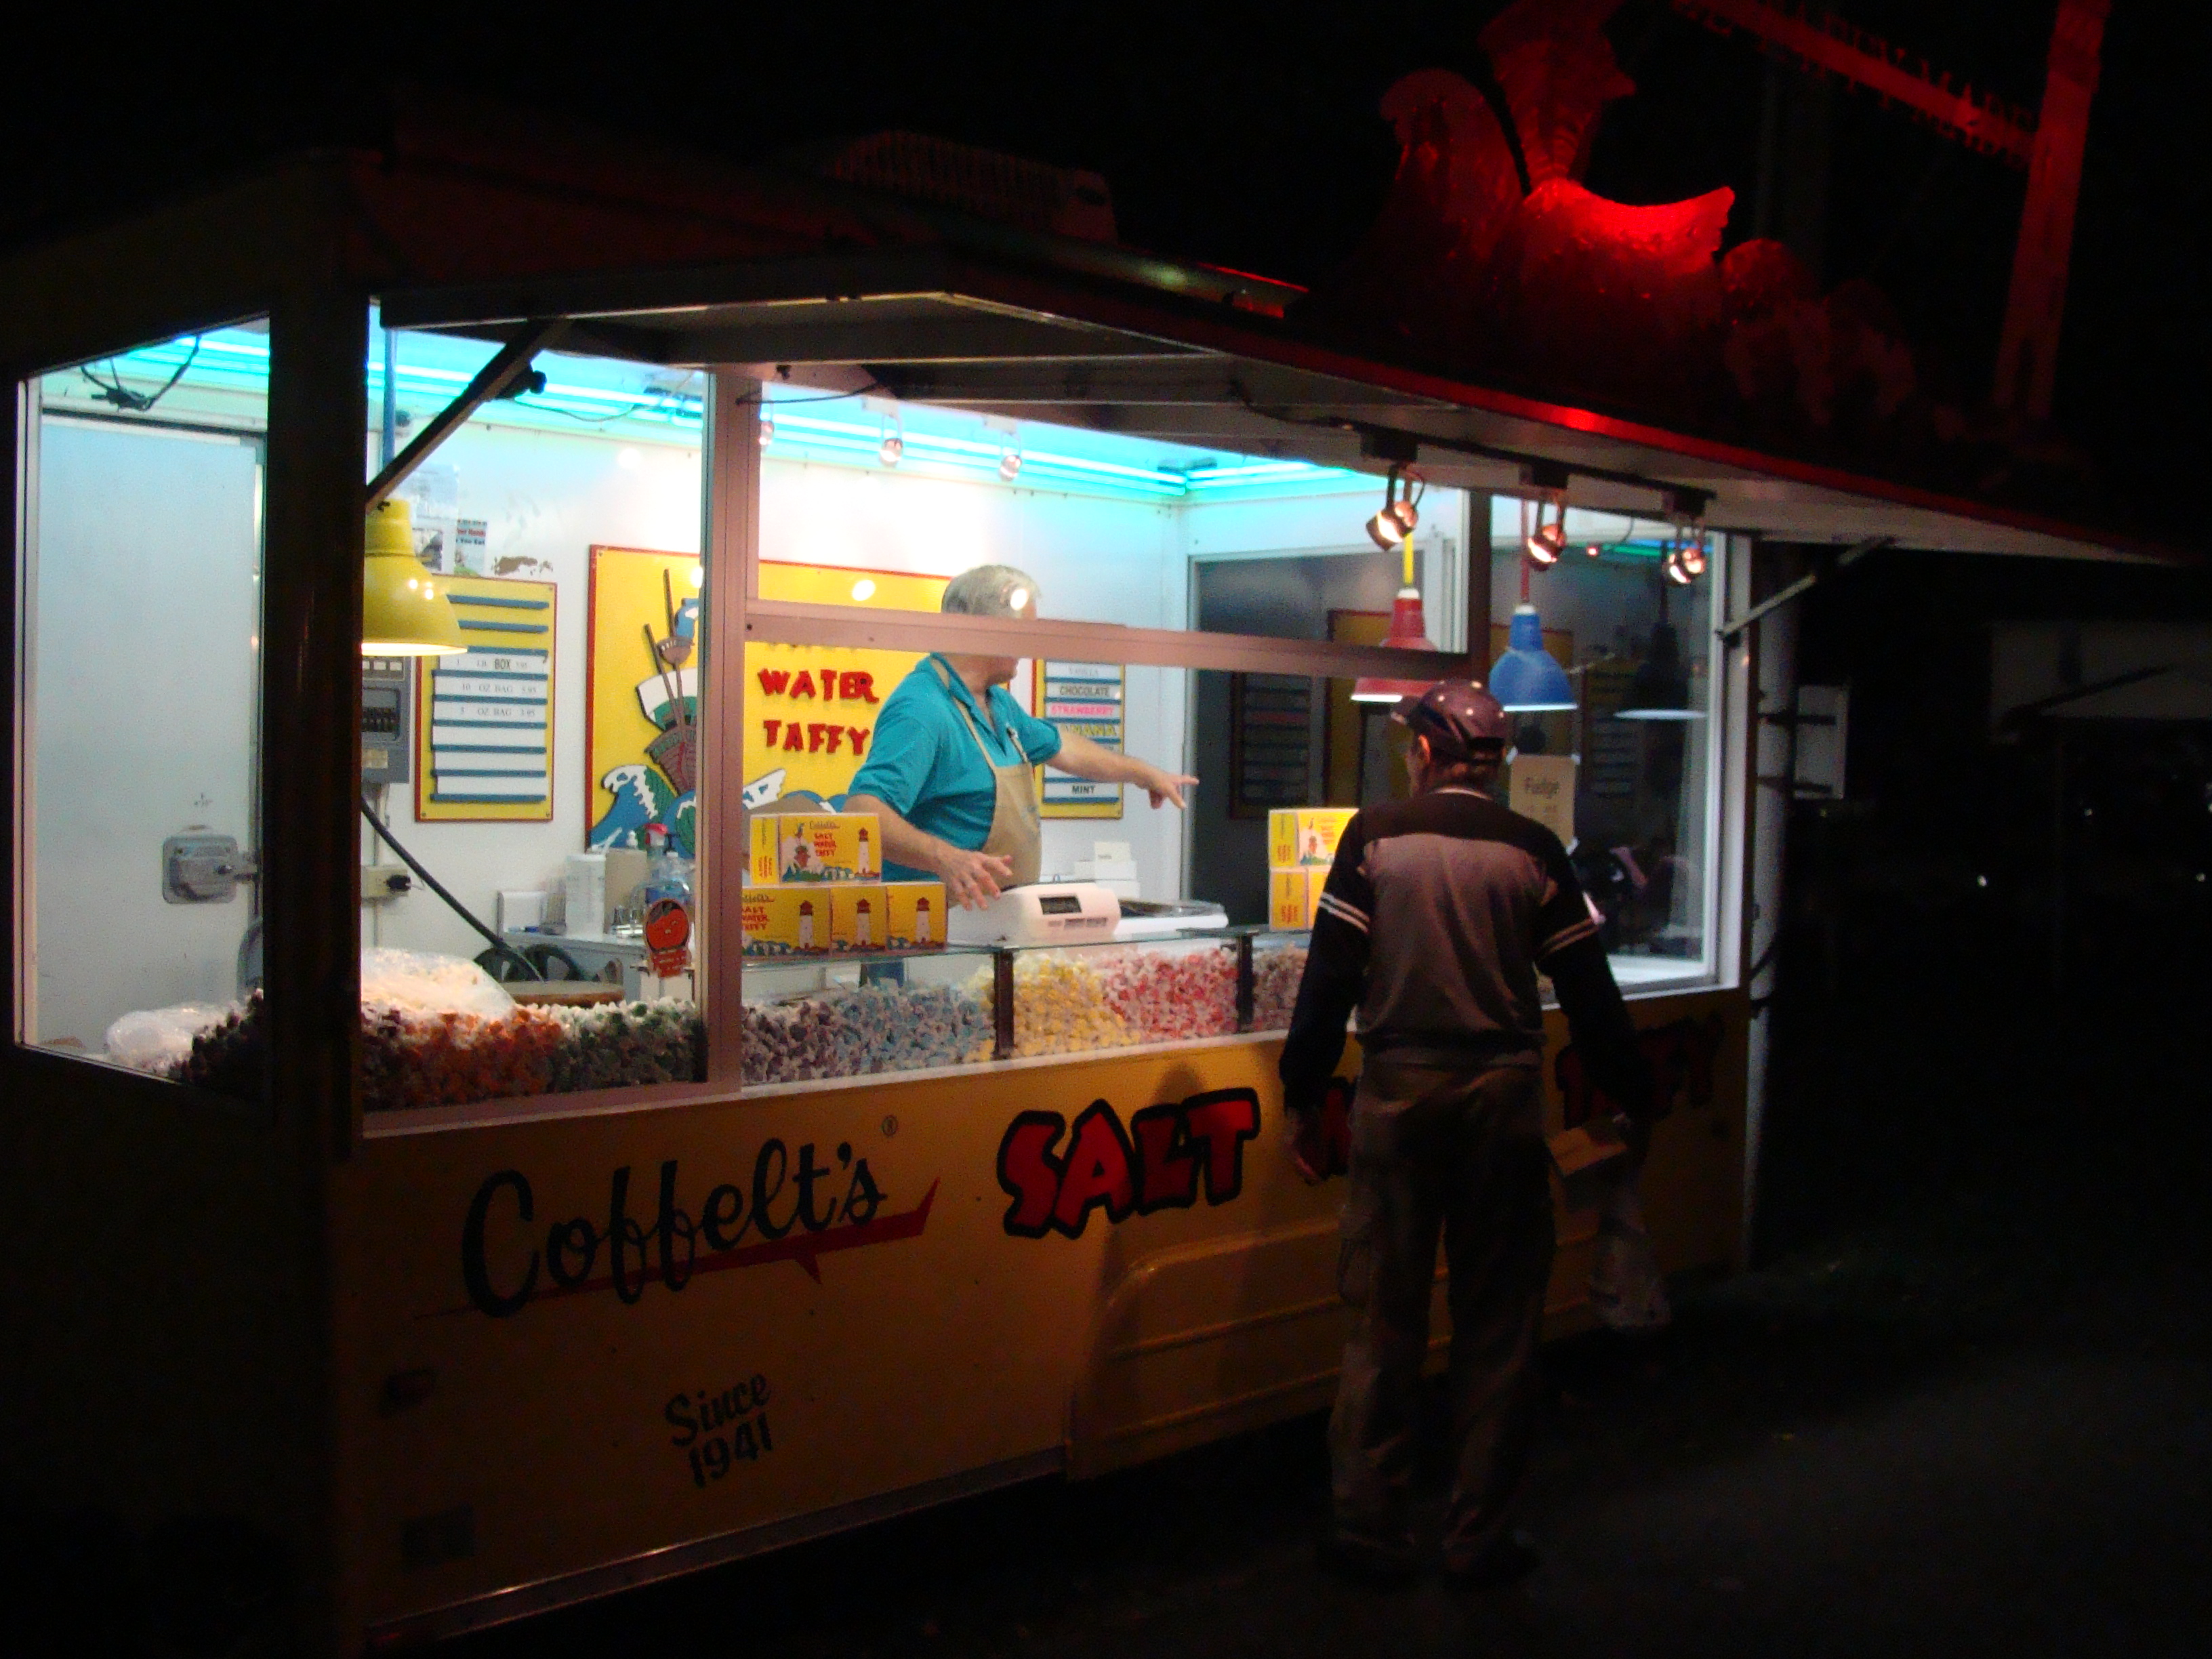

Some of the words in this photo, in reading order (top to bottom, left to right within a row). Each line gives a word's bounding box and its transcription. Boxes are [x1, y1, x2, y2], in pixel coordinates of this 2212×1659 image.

[494, 658, 511, 670] BOX
[478, 684, 491, 692] OZ
[495, 684, 514, 693] BAG
[757, 668, 880, 703] WATER
[1059, 685, 1110, 697] CHOCOLATE
[477, 708, 489, 716] OZ
[493, 708, 512, 716] BAG
[763, 720, 871, 756] TAFFY
[1071, 784, 1096, 795] MINT
[996, 1088, 1261, 1240] SALT
[462, 1138, 888, 1317] Coffelt's
[664, 1374, 773, 1448] Since
[689, 1411, 774, 1488] 1941
